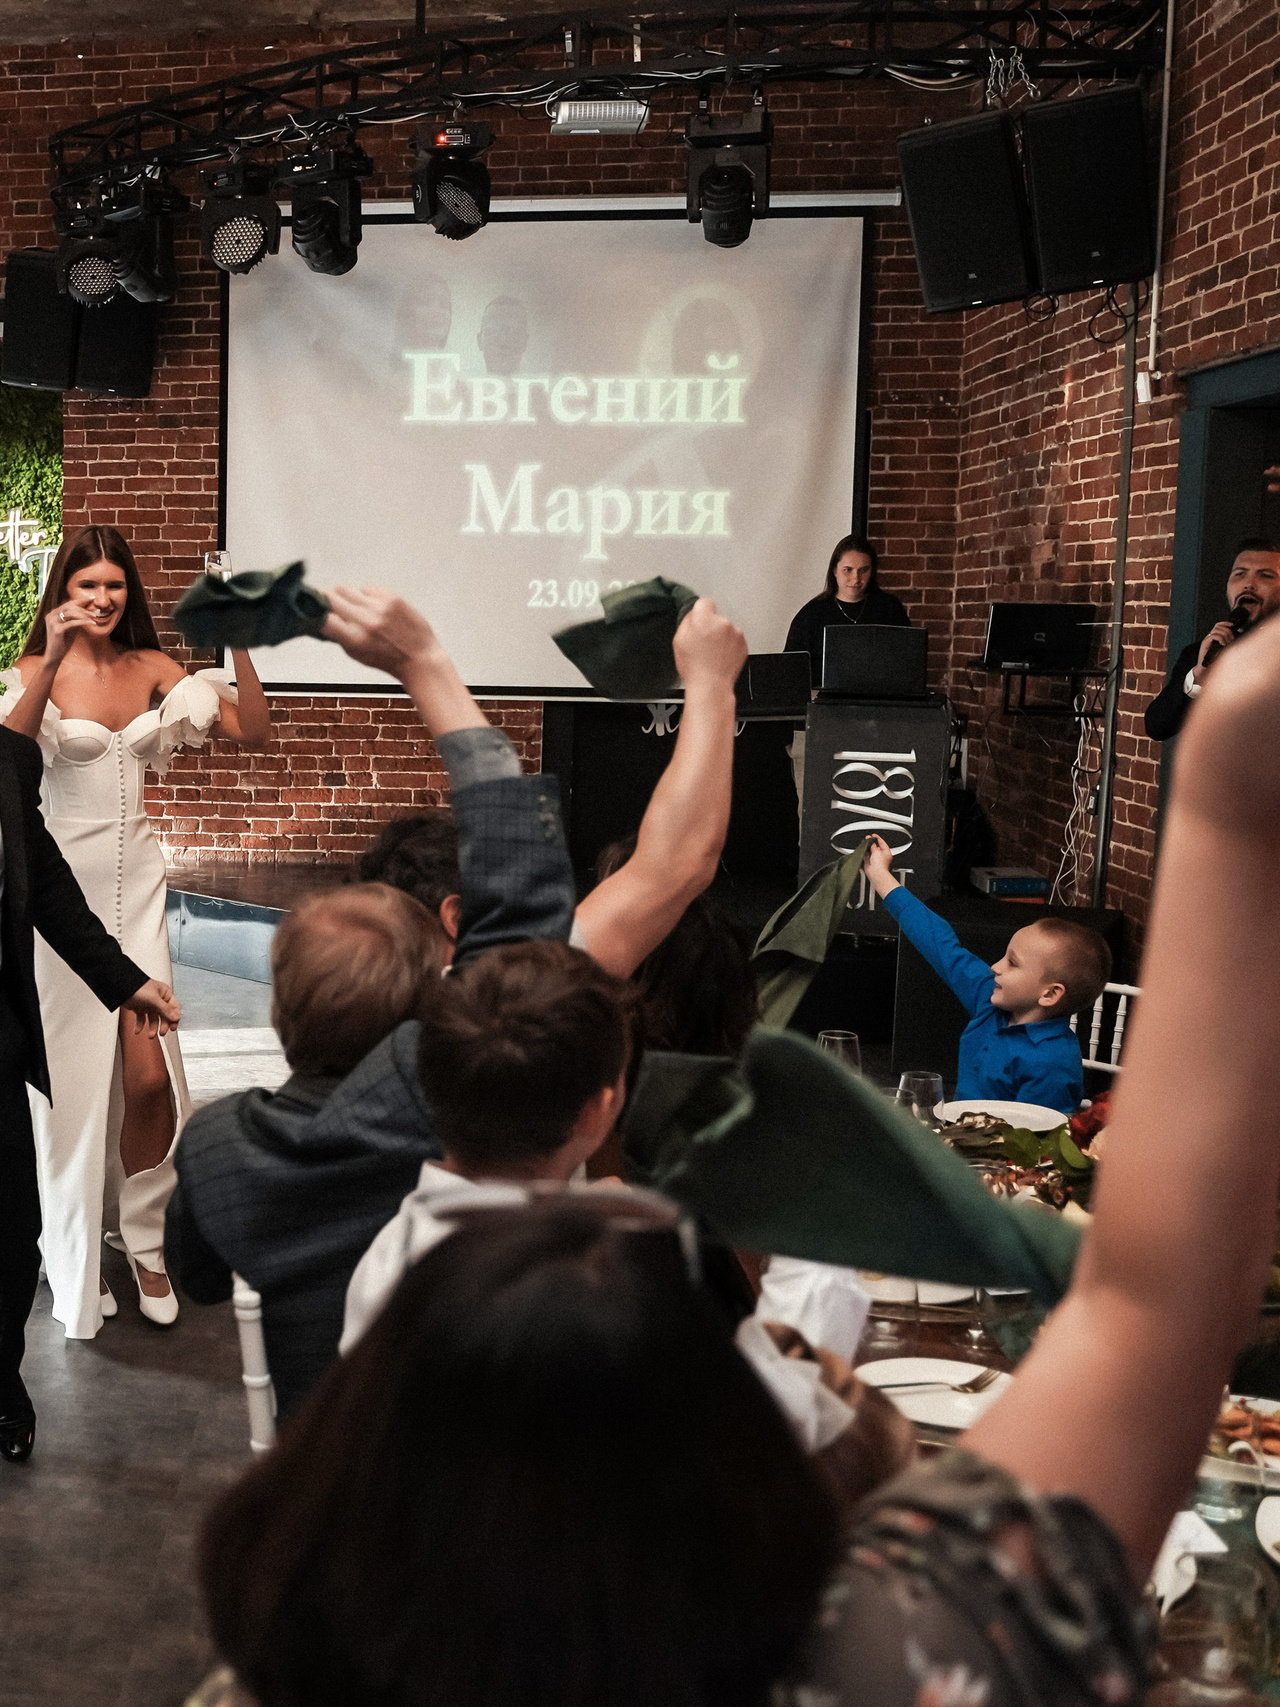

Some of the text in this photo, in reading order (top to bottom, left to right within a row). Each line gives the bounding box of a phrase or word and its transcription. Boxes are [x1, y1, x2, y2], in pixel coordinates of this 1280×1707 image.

[402, 352, 747, 424] Евгений
[461, 463, 732, 561] Мария
[527, 578, 638, 608] 23.09
[830, 750, 916, 857] 1870
